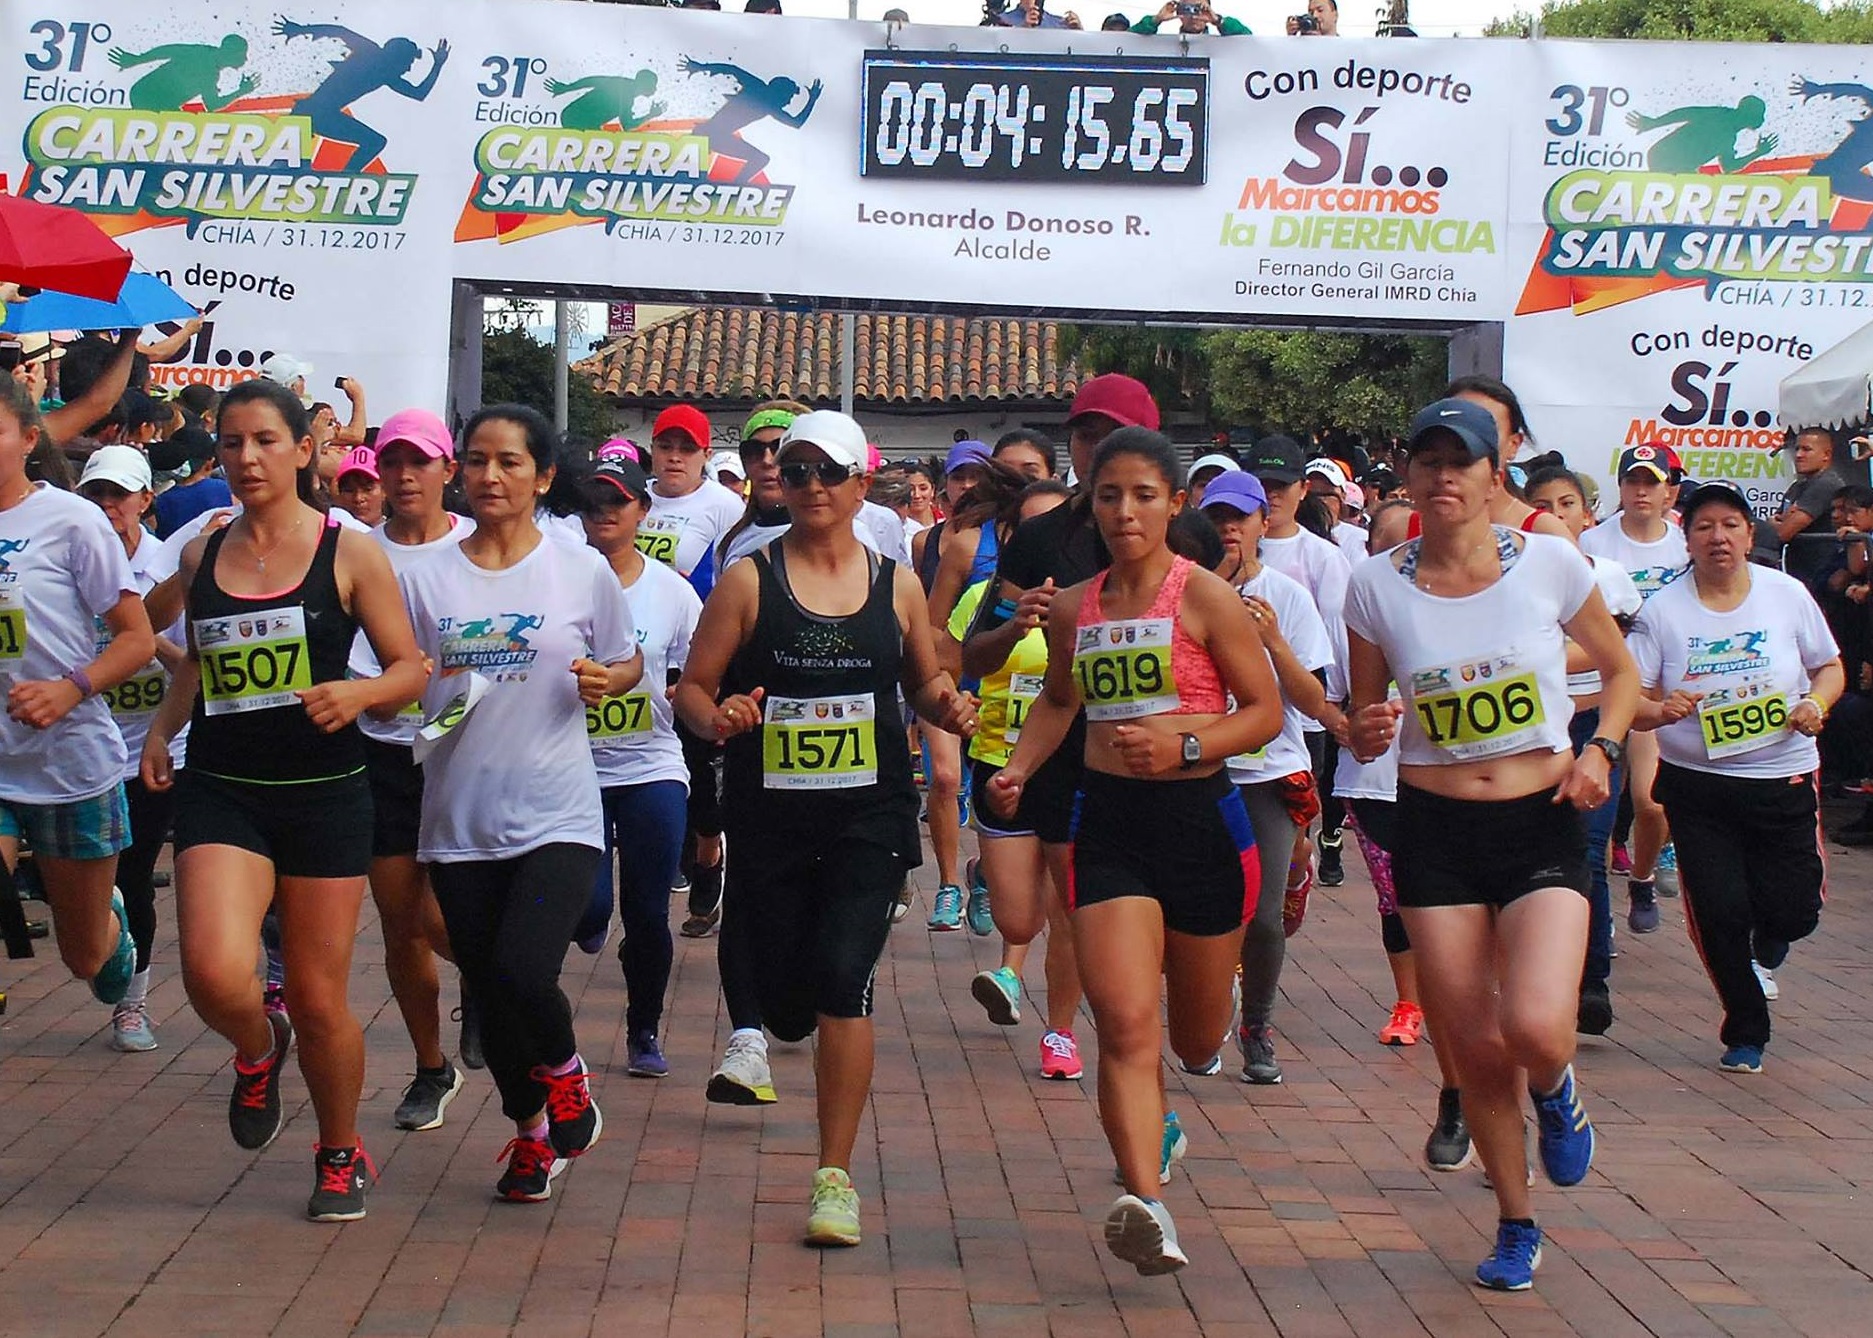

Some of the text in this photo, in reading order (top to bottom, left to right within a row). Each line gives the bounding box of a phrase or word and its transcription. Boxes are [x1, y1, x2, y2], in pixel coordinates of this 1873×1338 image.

[24, 76, 126, 105] Edición
[1245, 60, 1472, 103] Con deporte
[475, 101, 557, 125] Edición
[39, 115, 301, 167] CARRERA
[486, 134, 700, 178] CARRERA
[1282, 106, 1448, 187] Sí...
[1544, 141, 1643, 168] Edición
[33, 167, 410, 216] SAN SILVESTRE
[482, 174, 789, 219] SAN SILVESTRE
[1237, 178, 1439, 214] Marcamos
[1558, 178, 1819, 228] CARRERA
[203, 218, 256, 246] CHÍA
[281, 228, 407, 251] 31.12.2017
[618, 218, 662, 241] CHÍA
[682, 228, 784, 246] 31.12.2017
[857, 203, 1150, 236] Leonardo Donoso R.
[1220, 213, 1495, 254] la DIFERENCIA
[954, 238, 1051, 262] Alcalde
[1552, 229, 1873, 273] SAN SILVEST
[185, 263, 295, 300] deporte
[1259, 259, 1454, 280] Fernando Gil García
[1235, 281, 1305, 297] Director
[1312, 283, 1379, 299] General
[1385, 286, 1430, 301] IMRD
[1720, 279, 1774, 305] CHÍA
[1801, 288, 1873, 307] 31.12.
[1631, 324, 1813, 360] Con deporte
[353, 450, 367, 464] 10
[204, 643, 301, 695] 1507
[470, 651, 535, 666] SILVESTRE
[1079, 653, 1163, 700] 1619
[1417, 682, 1535, 742] 1706
[1705, 697, 1787, 744] 1596
[777, 728, 865, 769] 1571
